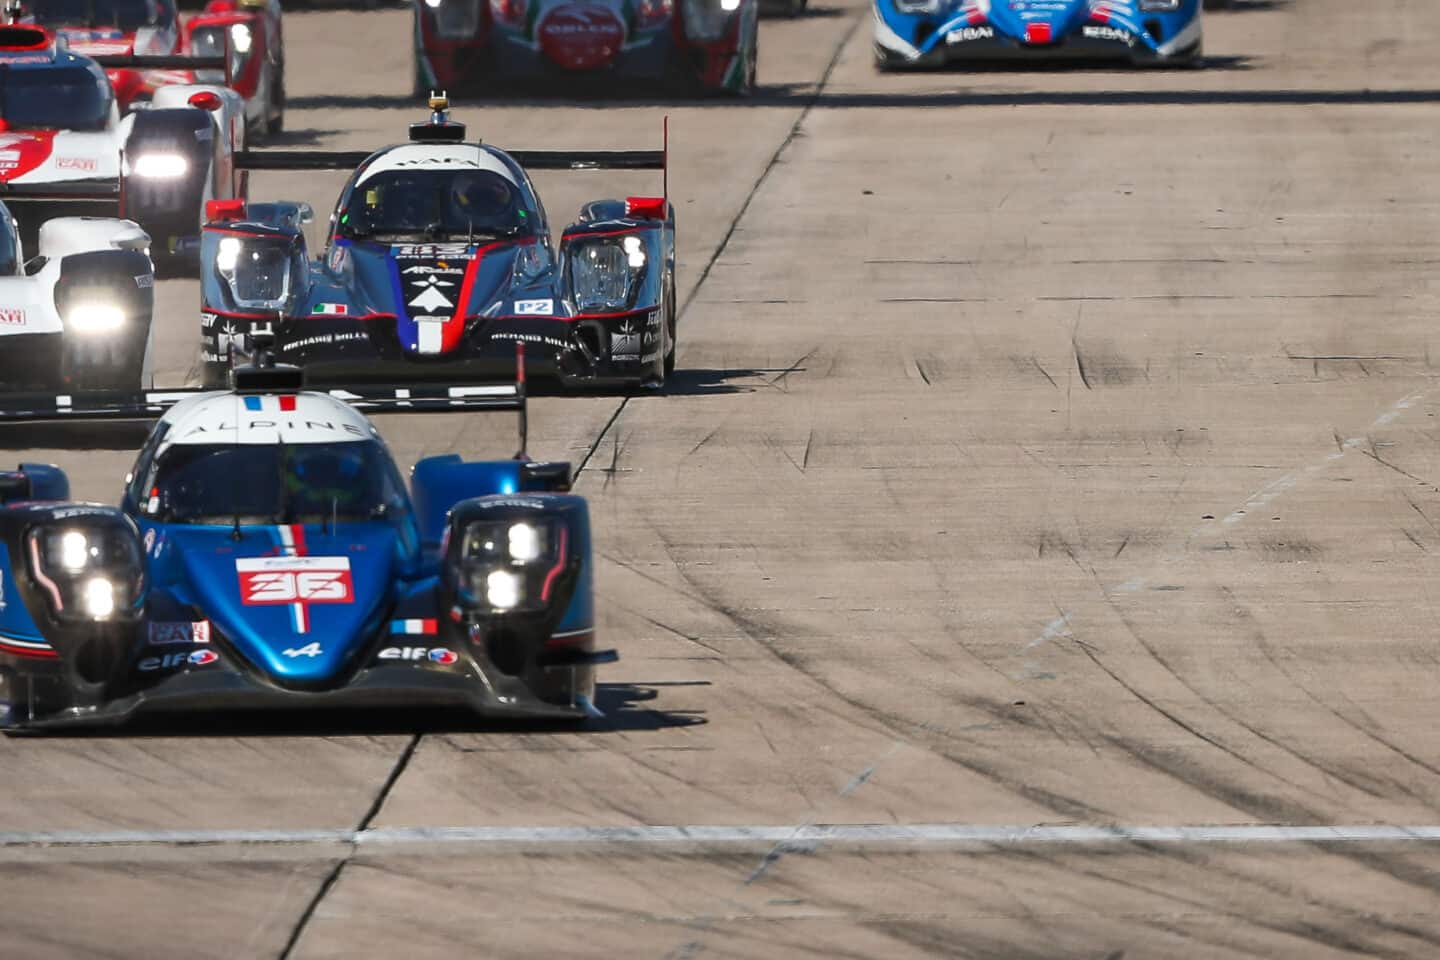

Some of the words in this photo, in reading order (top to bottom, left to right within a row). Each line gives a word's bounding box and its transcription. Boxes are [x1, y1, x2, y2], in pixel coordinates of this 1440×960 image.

[519, 302, 549, 313] P2
[185, 420, 365, 438] ALPINE
[248, 572, 347, 601] 36
[137, 652, 187, 671] elf
[378, 646, 427, 661] elf
